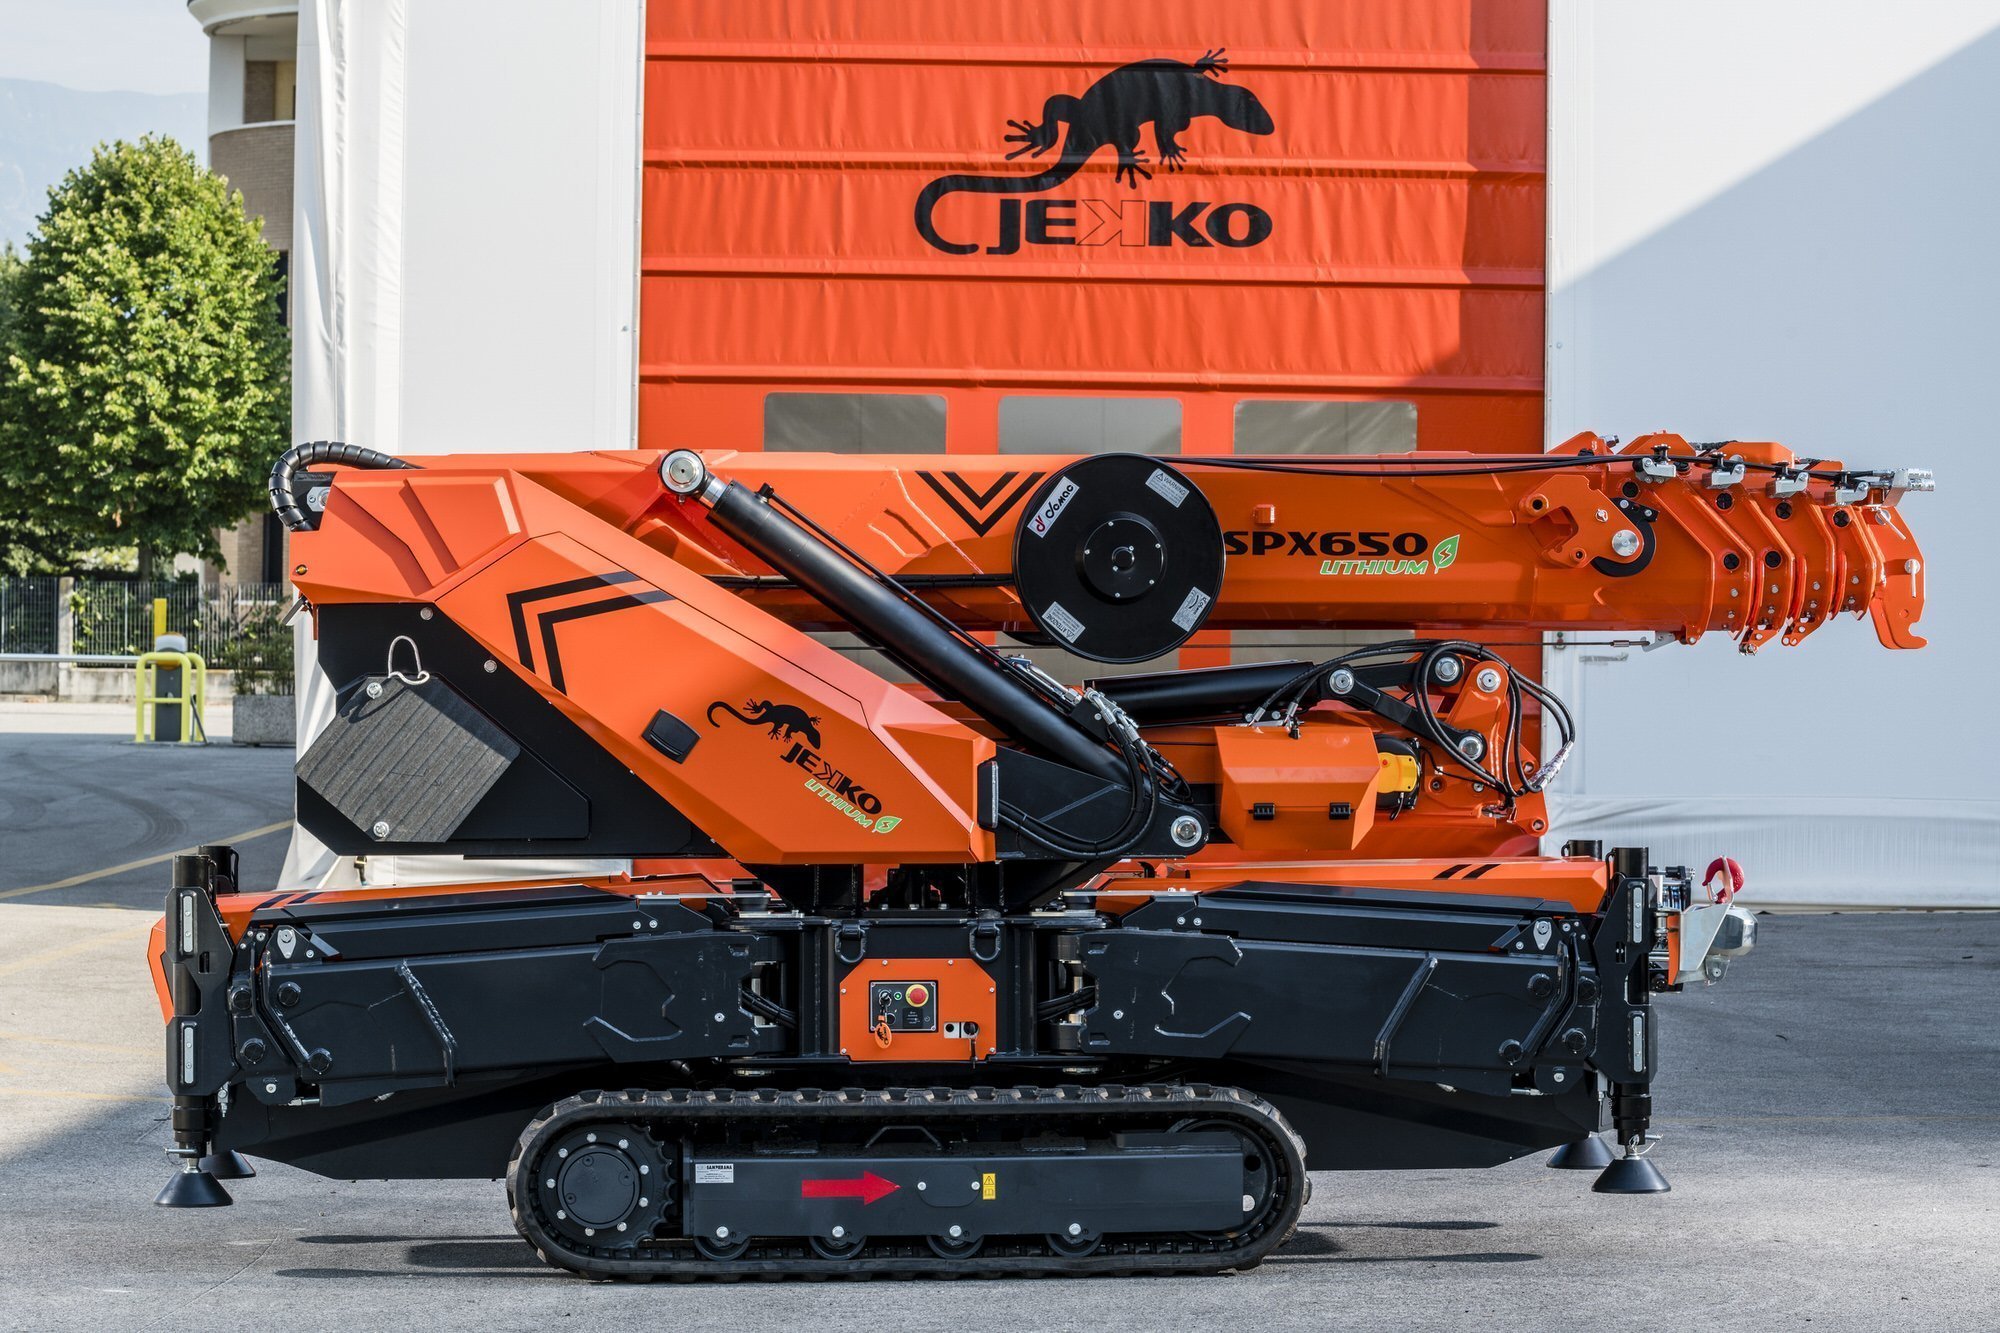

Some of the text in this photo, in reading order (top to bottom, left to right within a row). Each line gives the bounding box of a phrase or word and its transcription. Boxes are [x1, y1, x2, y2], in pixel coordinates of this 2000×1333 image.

[986, 199, 1273, 255] JEKKO
[1163, 476, 1186, 496] WARNING
[1223, 531, 1428, 557] SPX650
[1319, 559, 1429, 575] LITHIUM
[779, 742, 882, 815] JEKKO
[804, 778, 873, 829] LITHIUM
